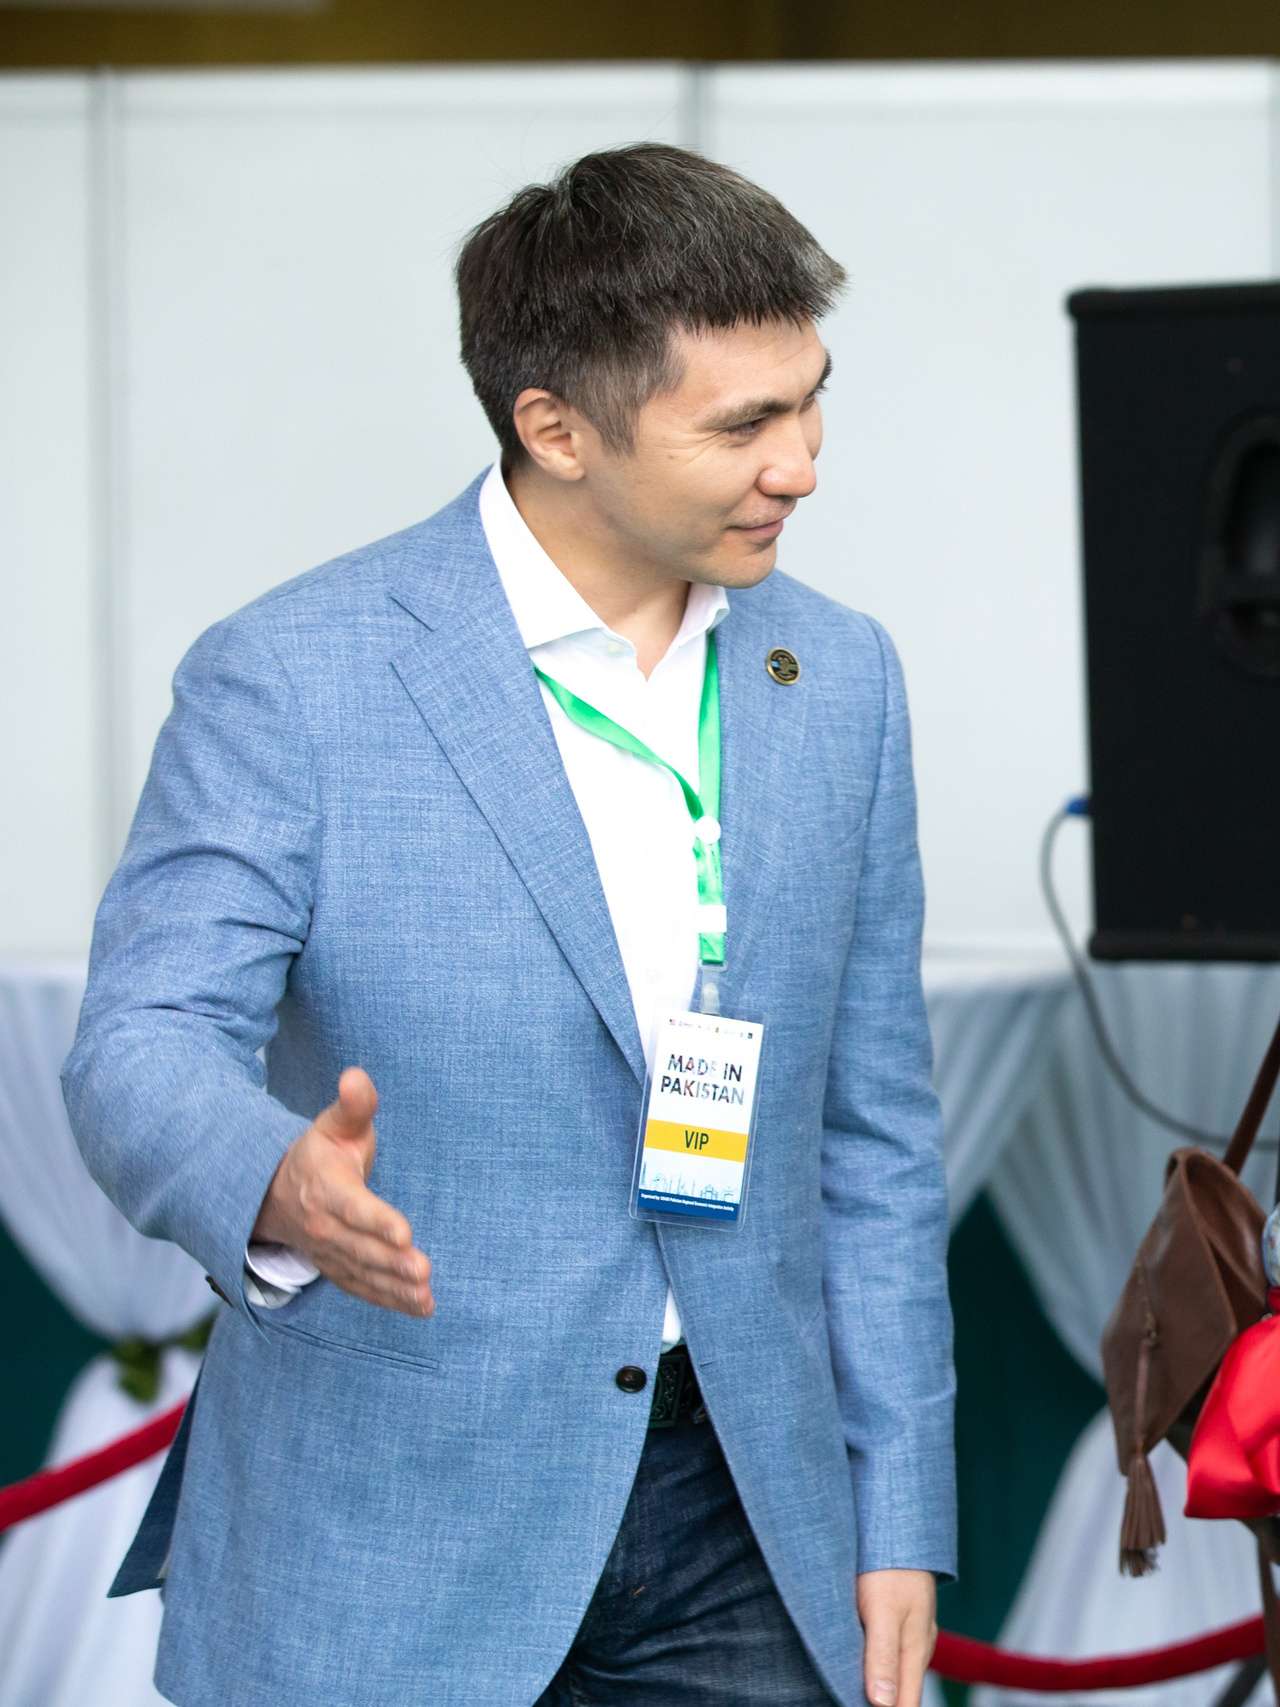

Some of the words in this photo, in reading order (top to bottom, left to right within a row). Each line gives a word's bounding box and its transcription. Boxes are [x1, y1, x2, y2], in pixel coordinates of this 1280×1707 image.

[667, 1053, 718, 1078] MADE
[723, 1062, 743, 1082] IN
[660, 1075, 745, 1106] PAKISTAN
[684, 1129, 709, 1151] VIP
